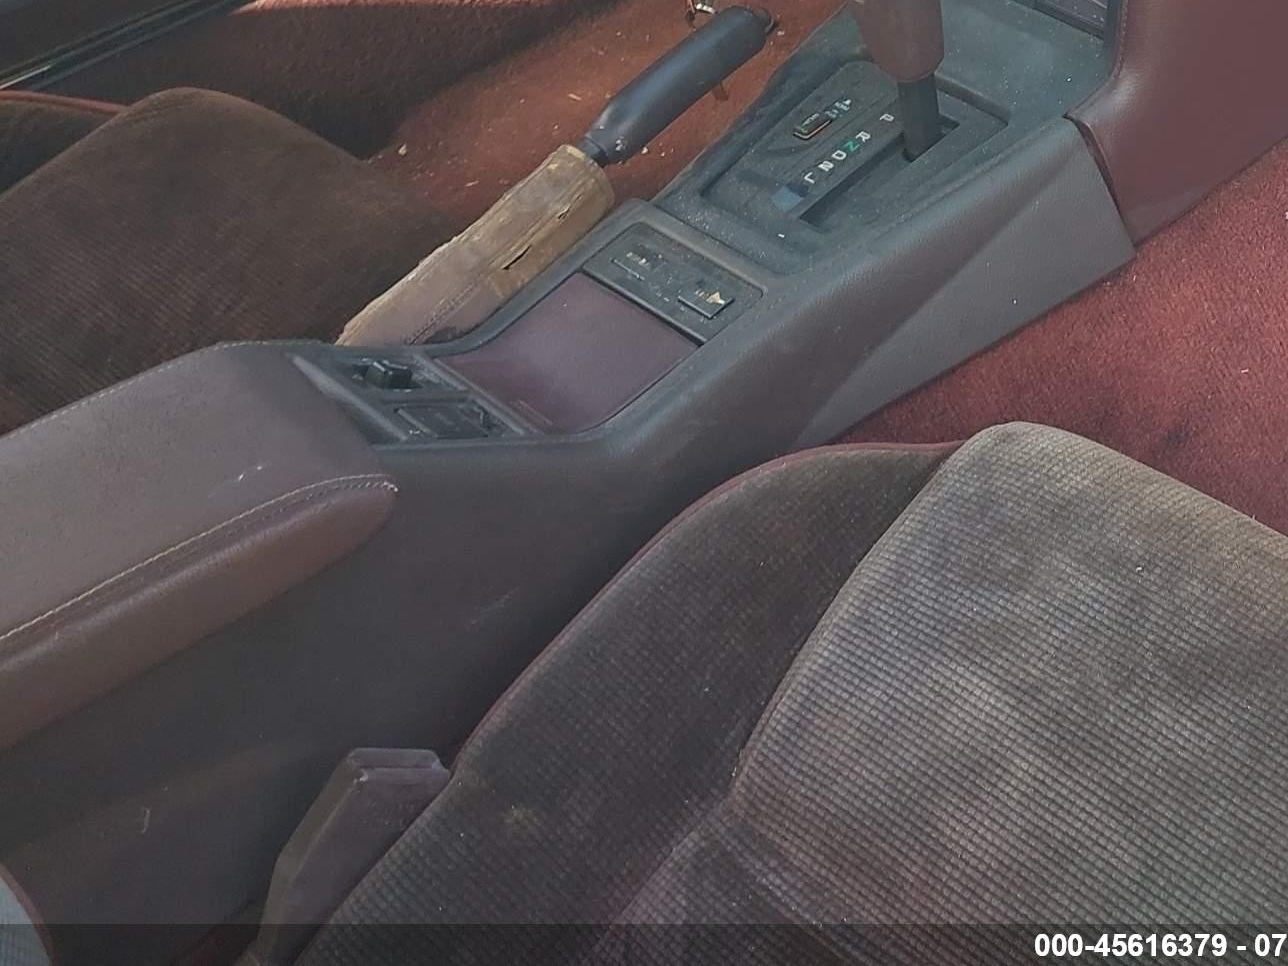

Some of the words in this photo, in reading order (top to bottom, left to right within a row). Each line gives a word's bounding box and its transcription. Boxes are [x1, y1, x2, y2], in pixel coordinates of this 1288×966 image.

[880, 113, 895, 123] P
[855, 131, 871, 143] R
[843, 141, 860, 152] N
[831, 150, 847, 161] D
[803, 172, 816, 184] L
